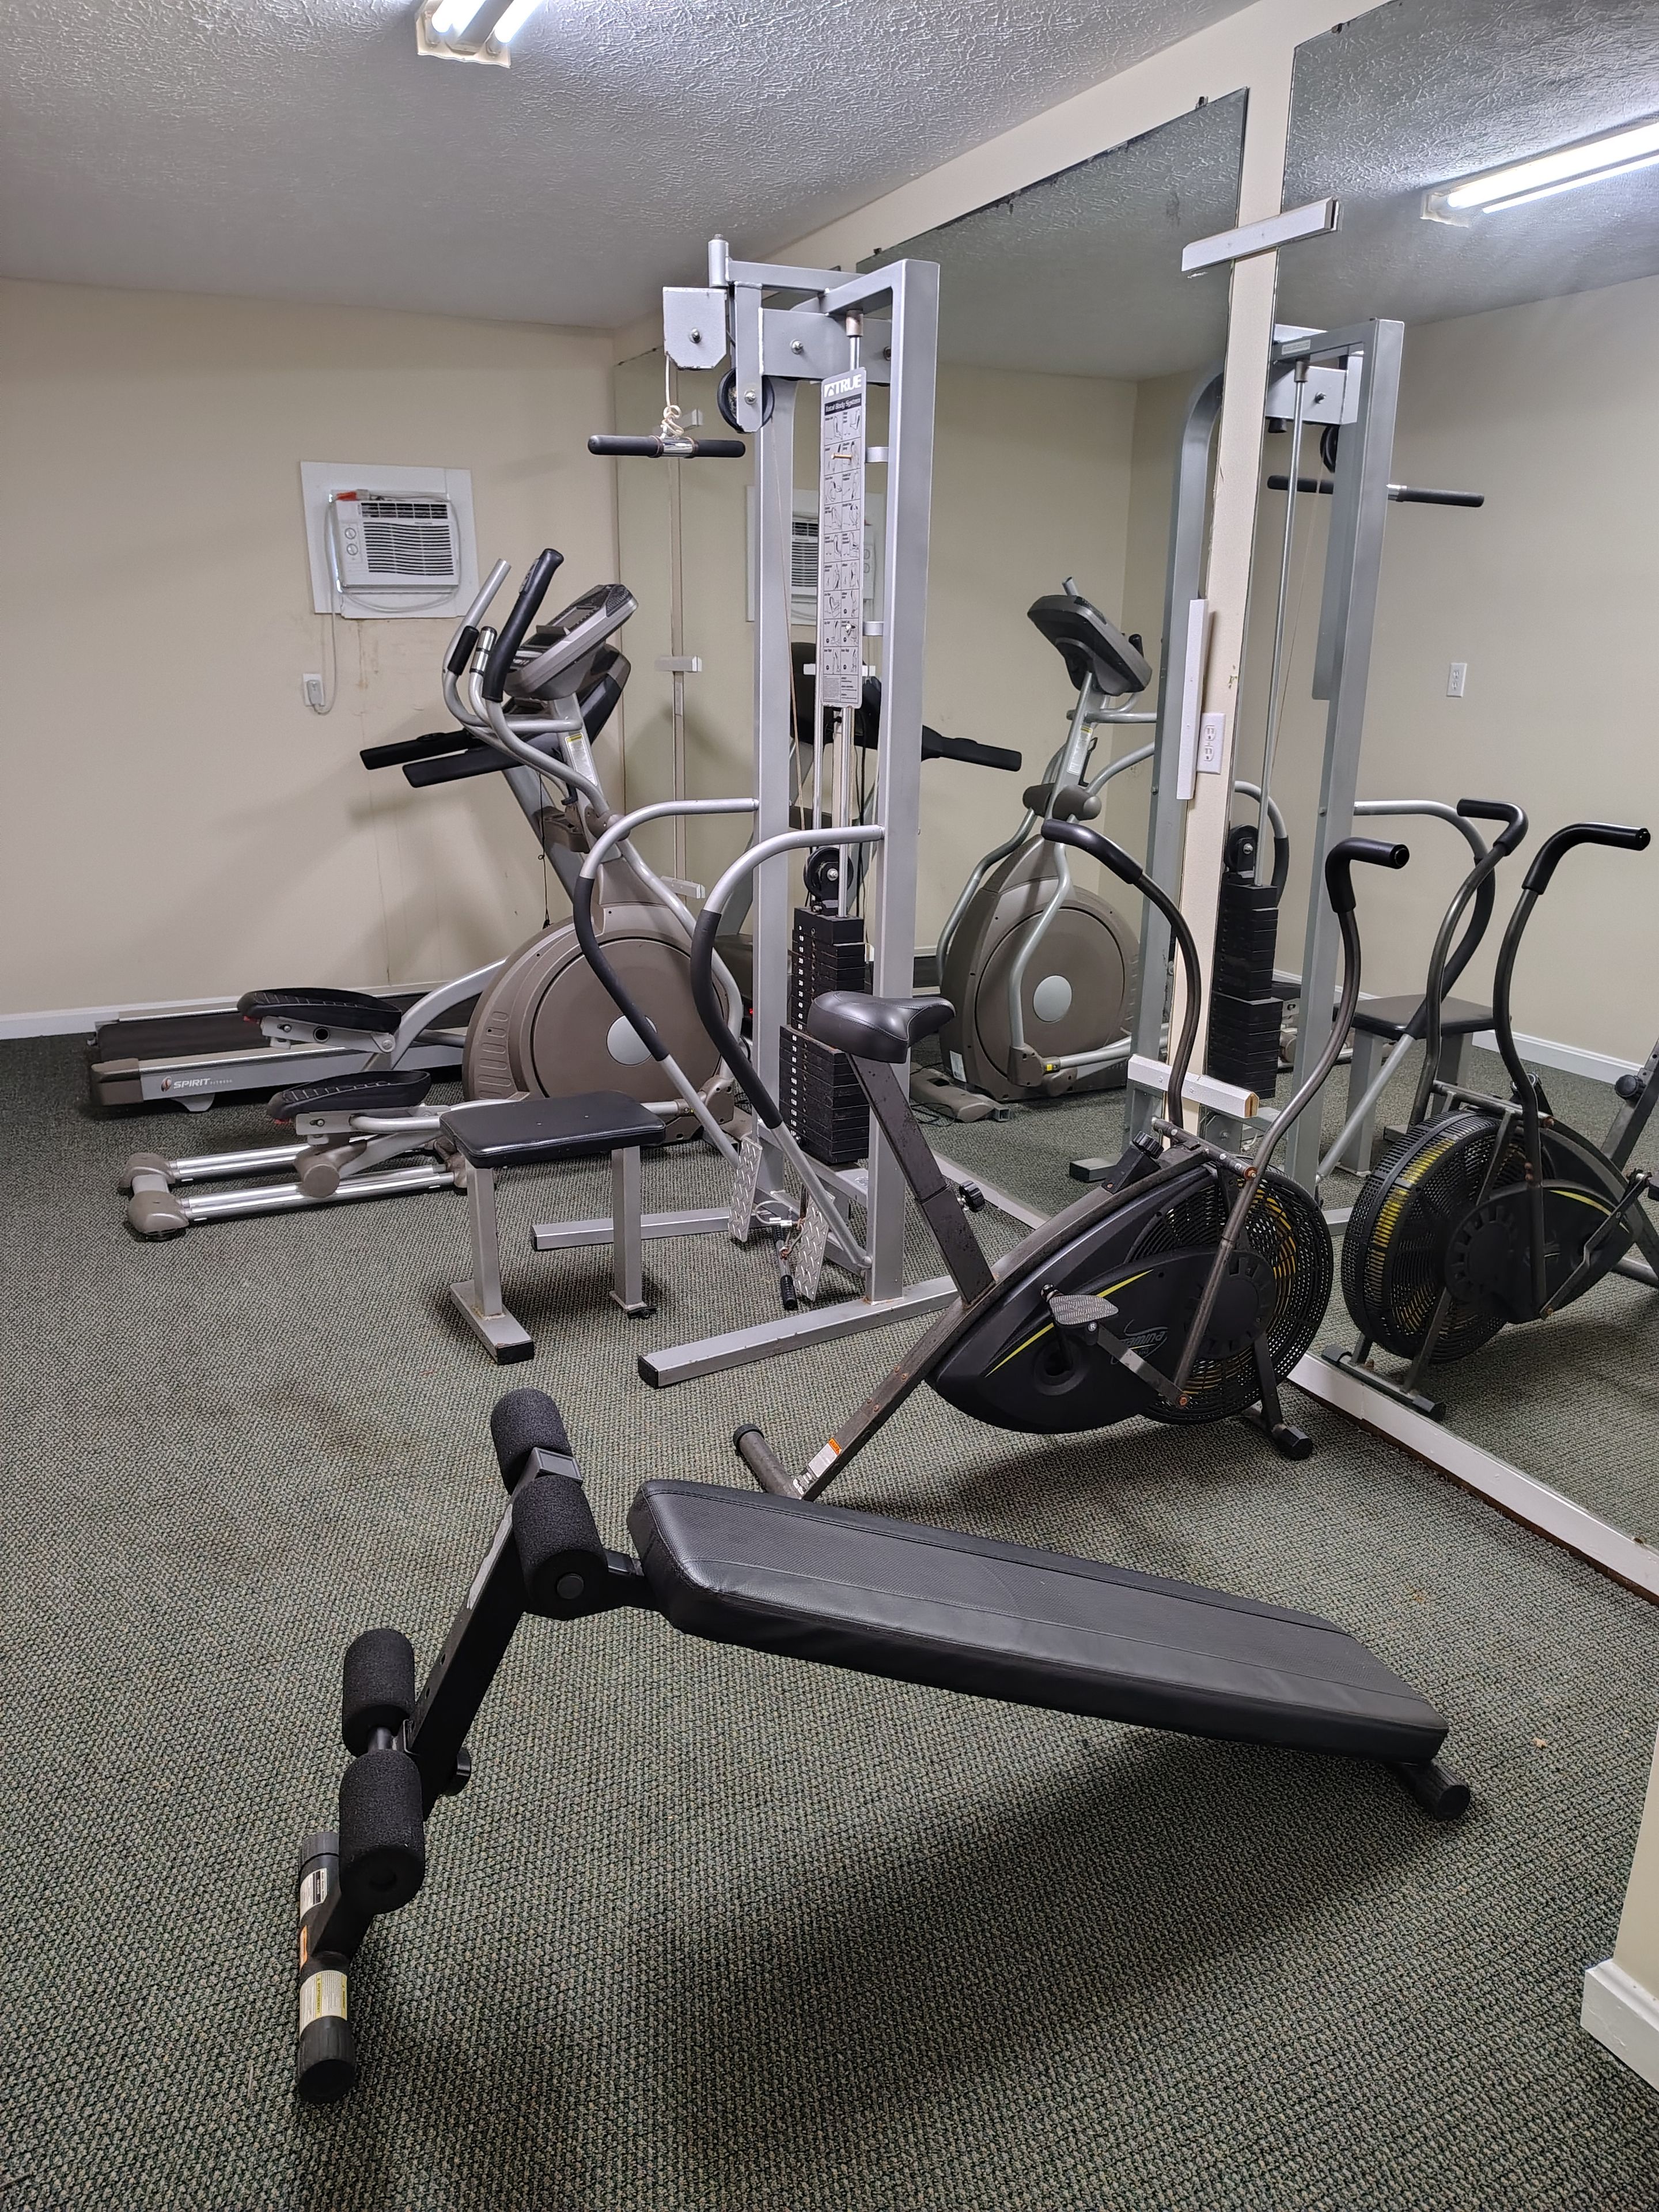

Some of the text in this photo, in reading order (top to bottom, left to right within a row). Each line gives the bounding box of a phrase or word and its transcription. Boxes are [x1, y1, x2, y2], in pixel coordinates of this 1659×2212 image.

[834, 374, 862, 394] TRUE
[825, 397, 861, 412] Total Body System
[173, 1078, 210, 1089] SPIRIT
